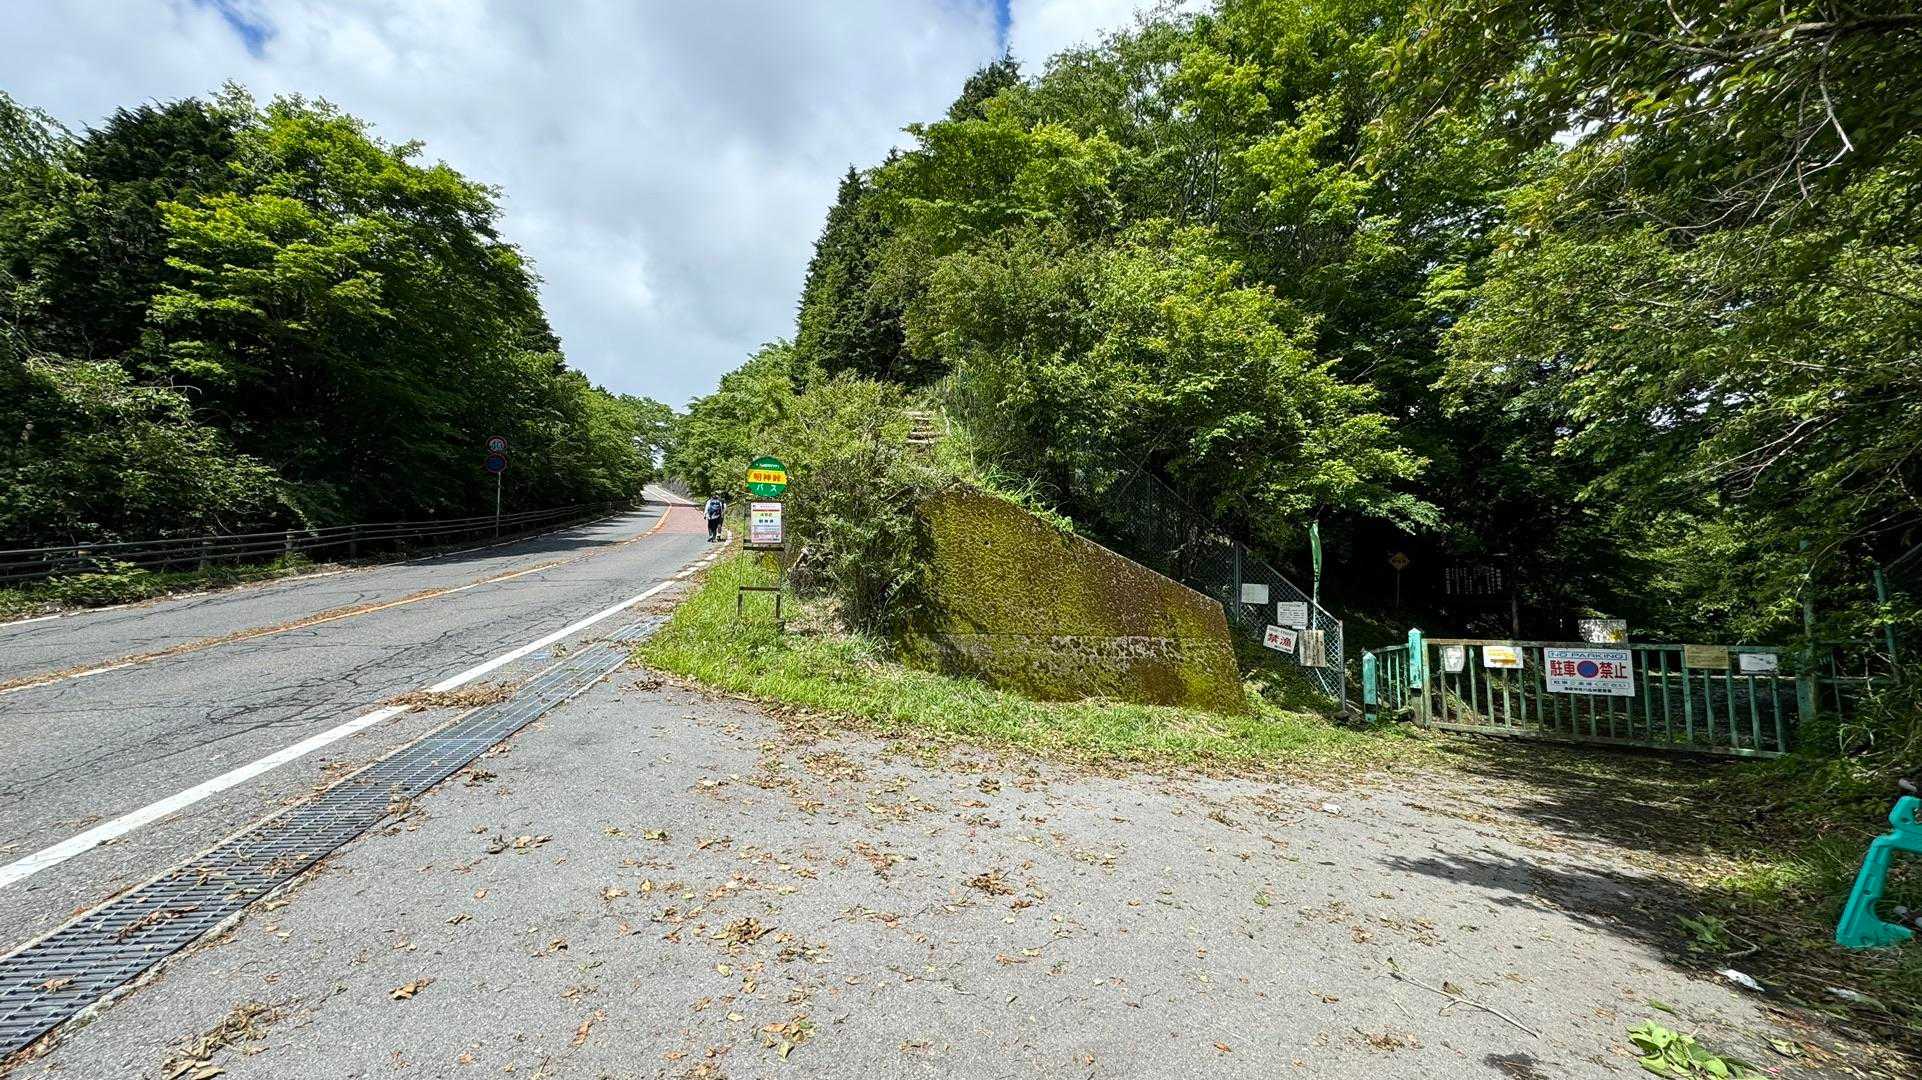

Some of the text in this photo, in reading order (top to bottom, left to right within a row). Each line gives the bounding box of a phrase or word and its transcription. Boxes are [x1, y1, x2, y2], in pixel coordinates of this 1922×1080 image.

[756, 483, 777, 492] バス
[1550, 660, 1628, 679] 駐車 禁止
